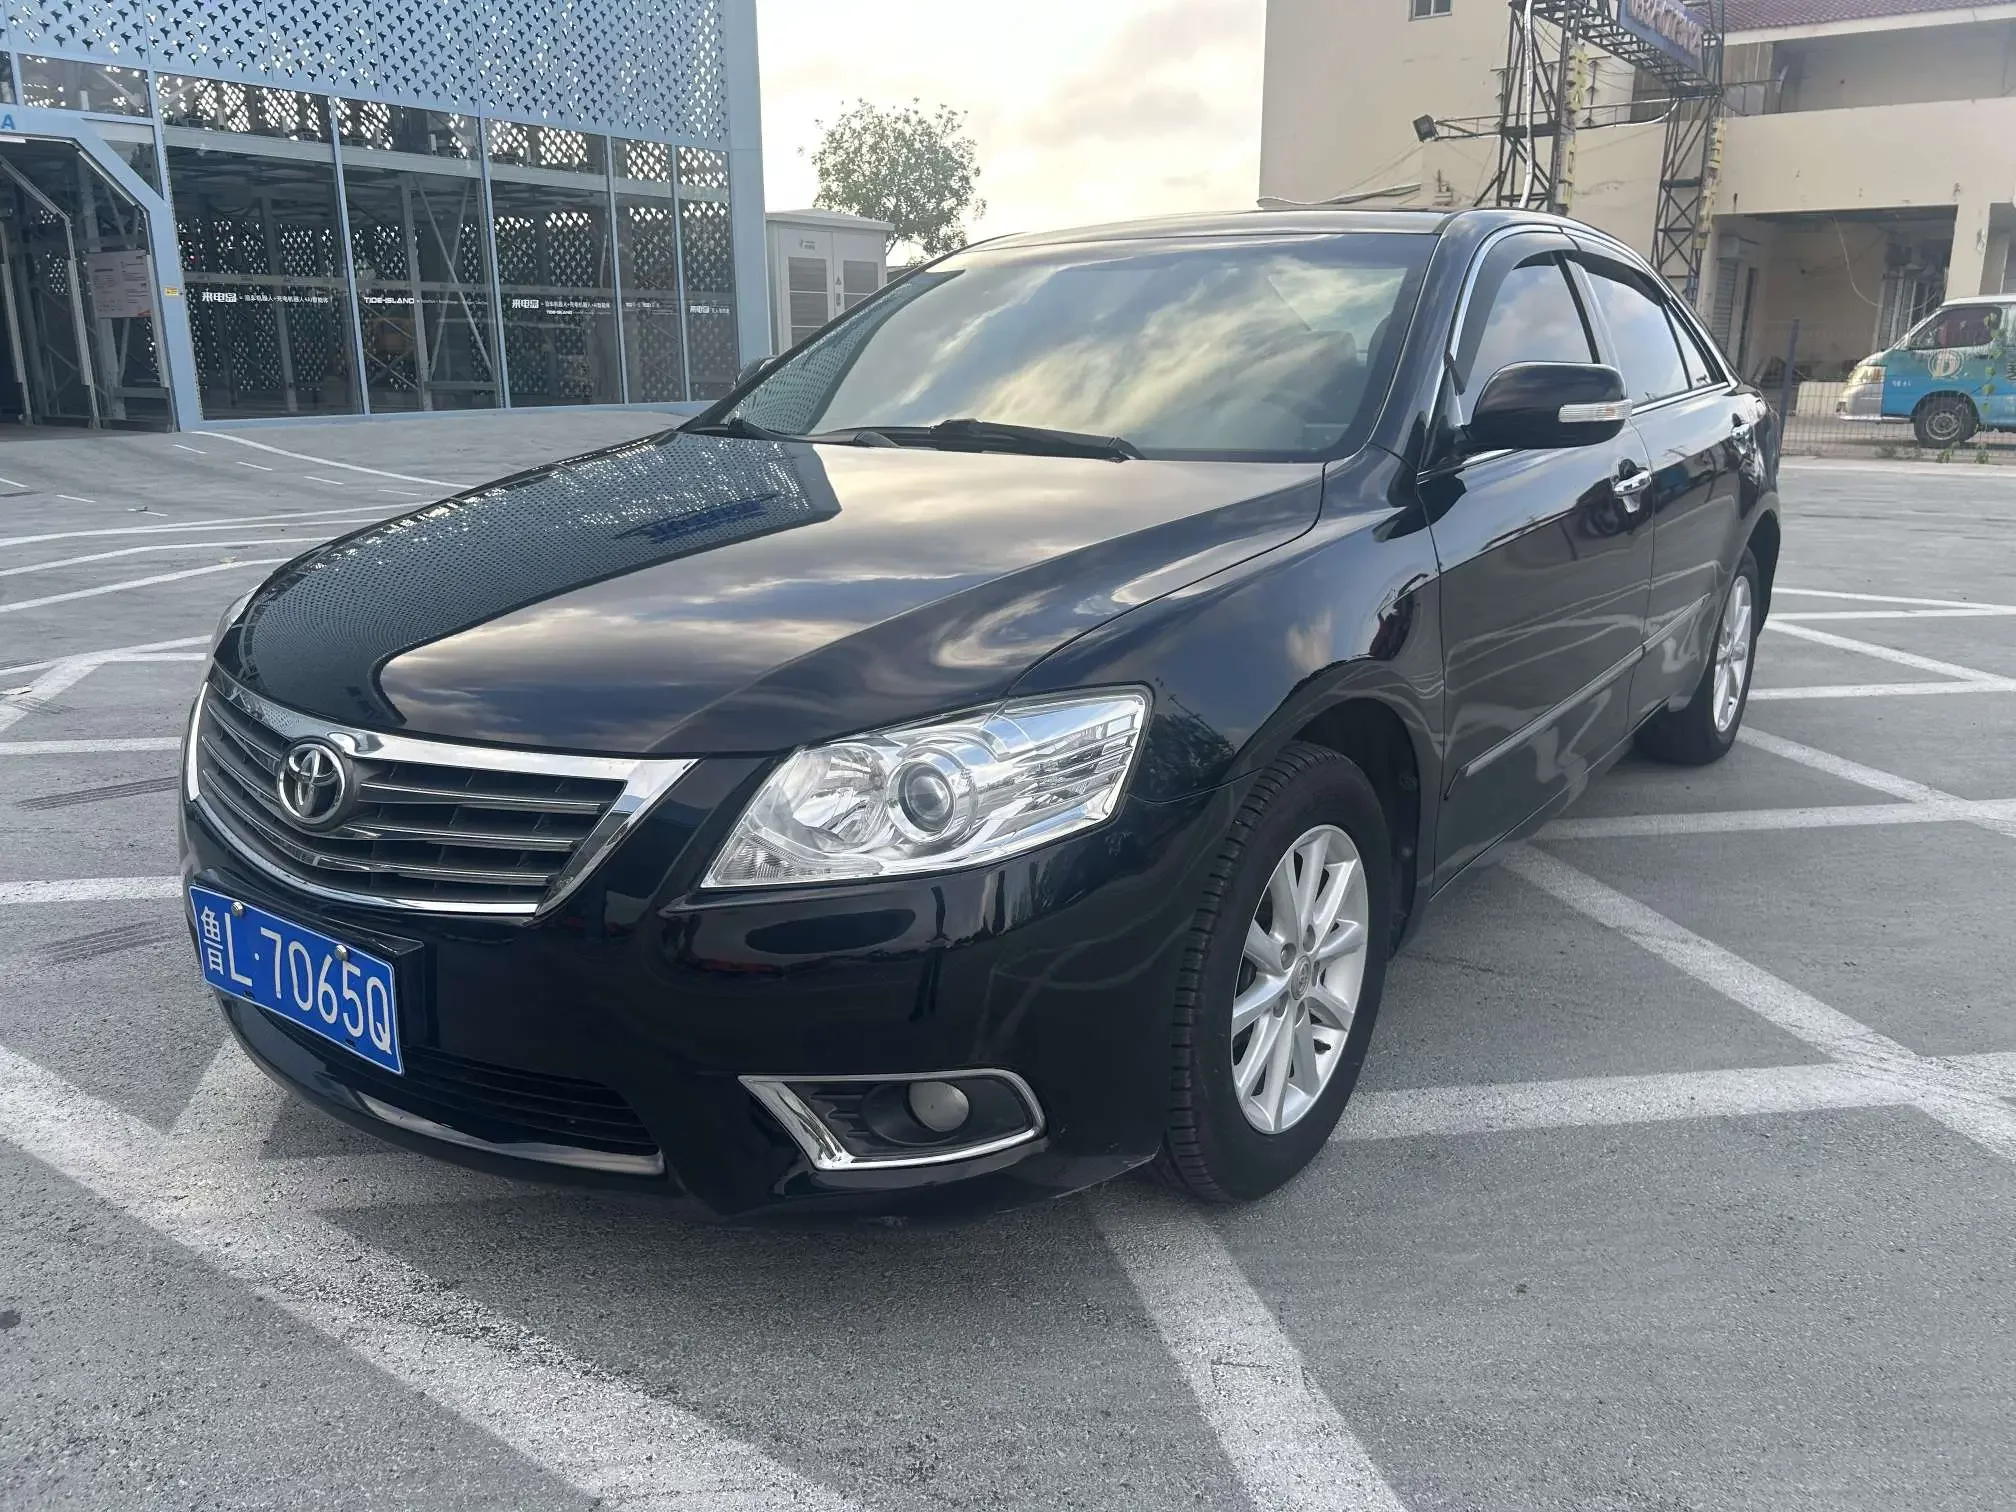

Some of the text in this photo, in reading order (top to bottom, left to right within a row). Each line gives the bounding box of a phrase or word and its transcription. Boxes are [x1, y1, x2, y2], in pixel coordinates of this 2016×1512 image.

[1, 114, 16, 130] A
[201, 291, 237, 303] 来电岛
[363, 296, 415, 305] TIDE-ISLAND
